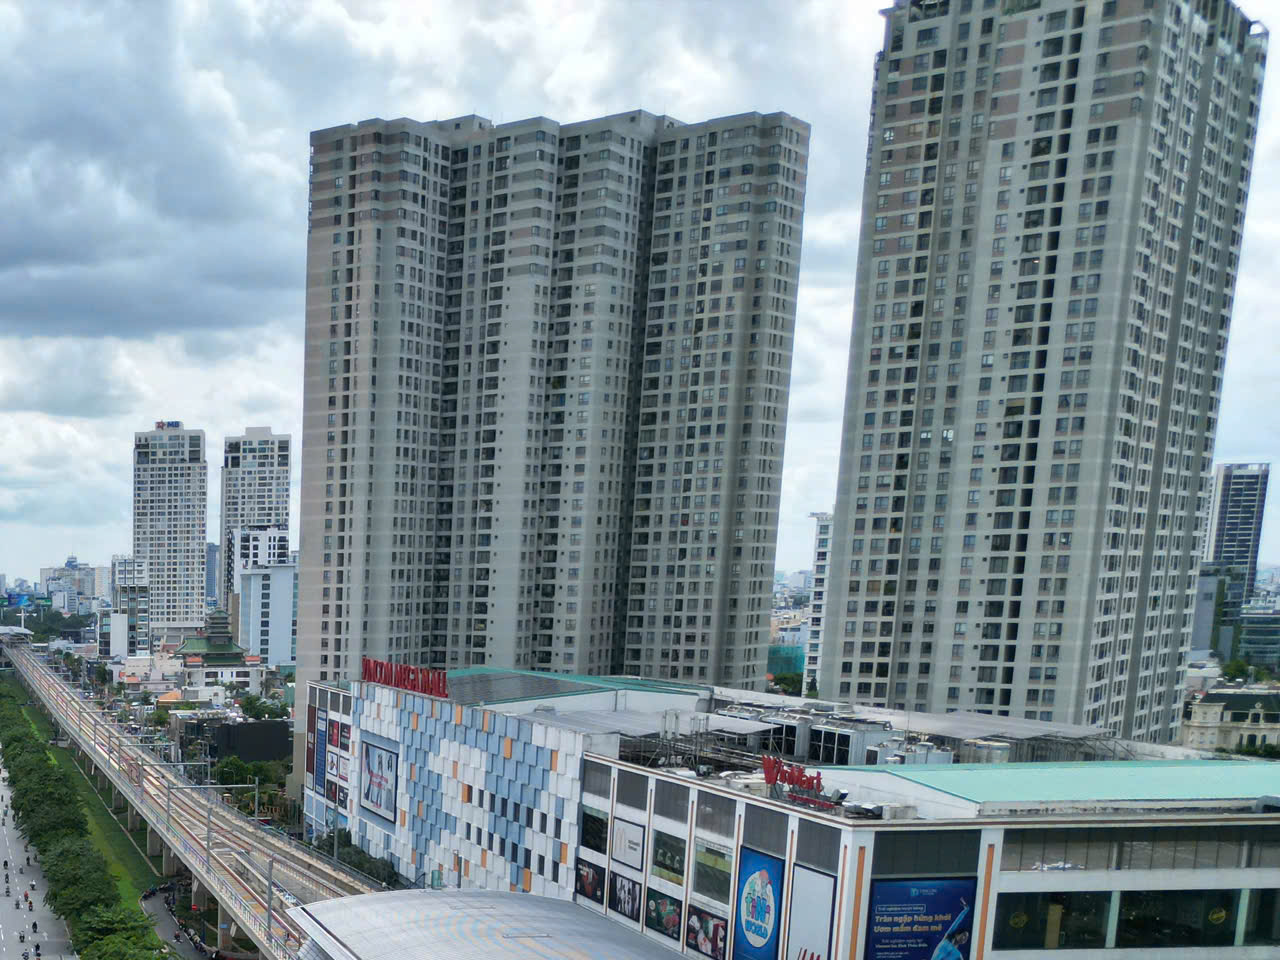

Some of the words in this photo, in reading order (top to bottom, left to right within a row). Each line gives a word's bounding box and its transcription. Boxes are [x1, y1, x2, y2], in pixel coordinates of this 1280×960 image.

[395, 663, 421, 693] MEGA
[422, 668, 449, 698] MALL
[762, 754, 823, 793] WinMart
